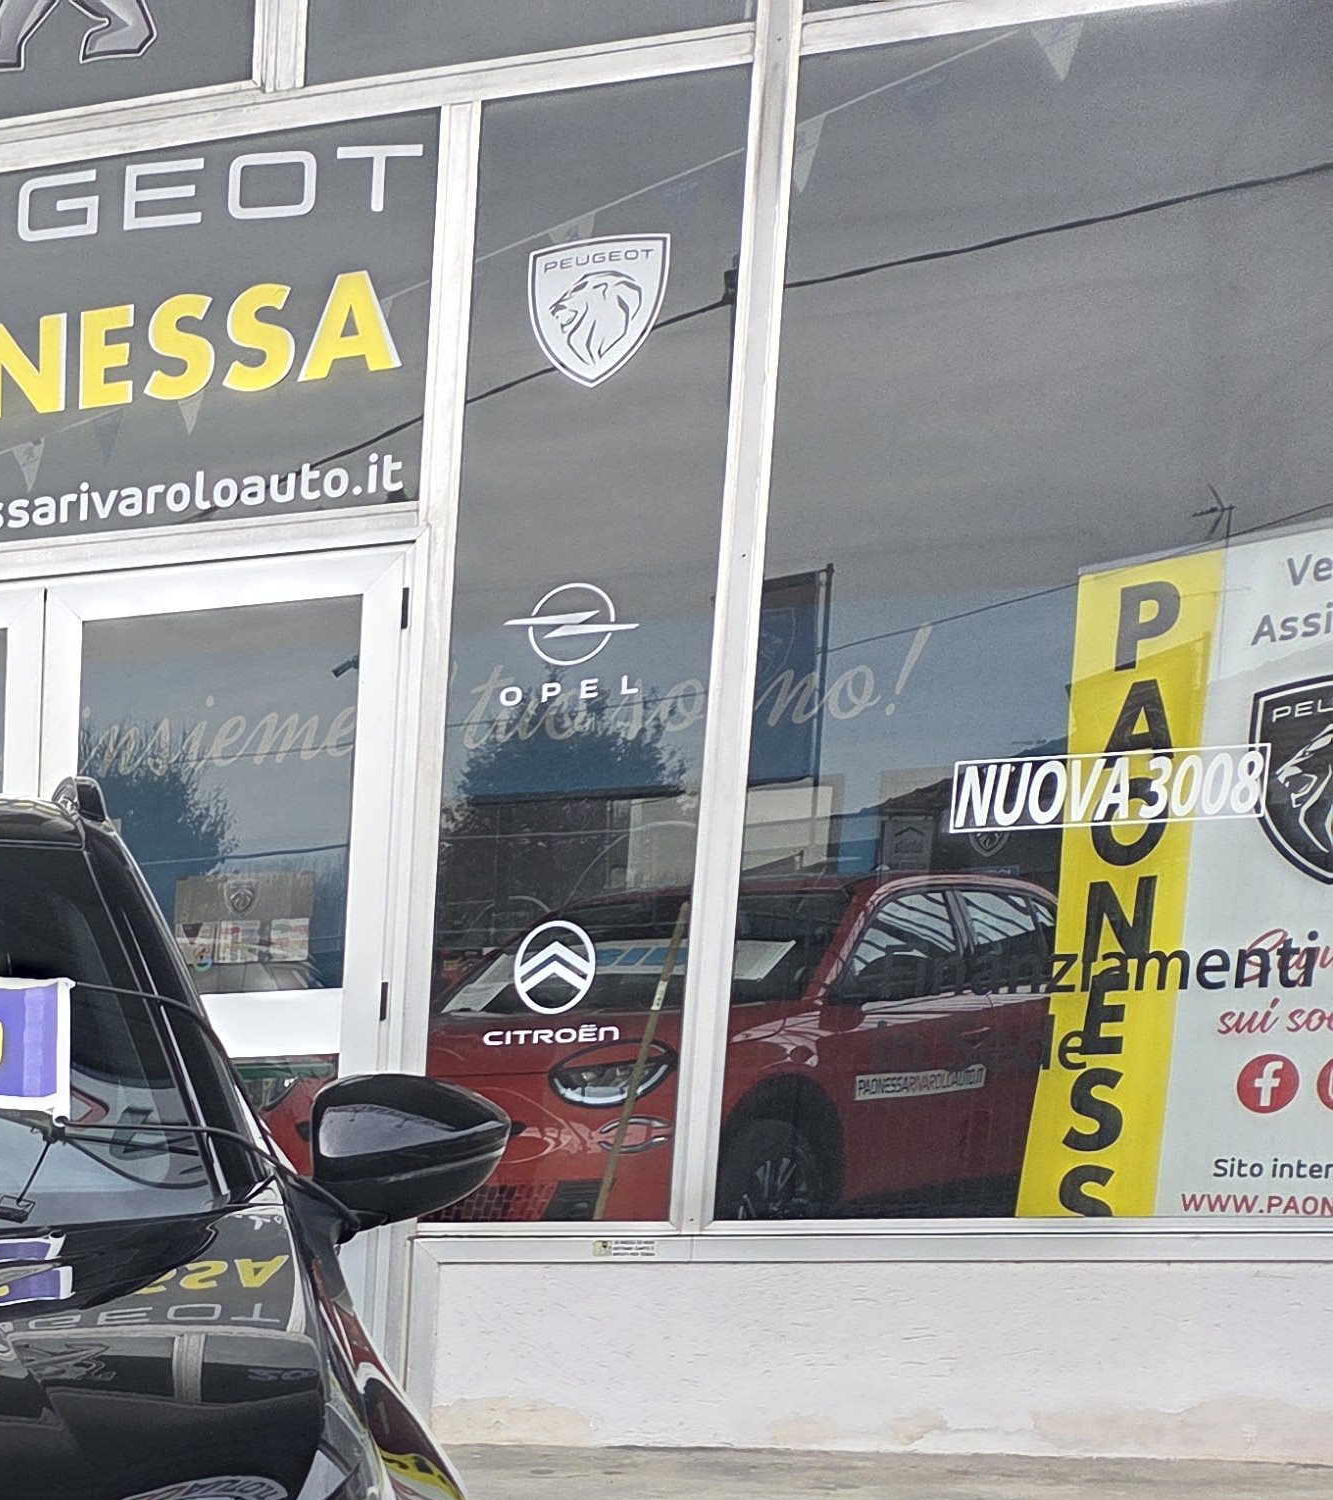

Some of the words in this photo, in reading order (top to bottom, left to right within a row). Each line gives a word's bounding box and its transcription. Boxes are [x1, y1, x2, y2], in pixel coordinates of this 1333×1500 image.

[542, 247, 655, 274] PEUGEOT
[499, 675, 639, 707] OPEL
[954, 755, 1132, 829] NUOVA
[1137, 751, 1264, 821] 3008
[1212, 1157, 1264, 1179] Sito
